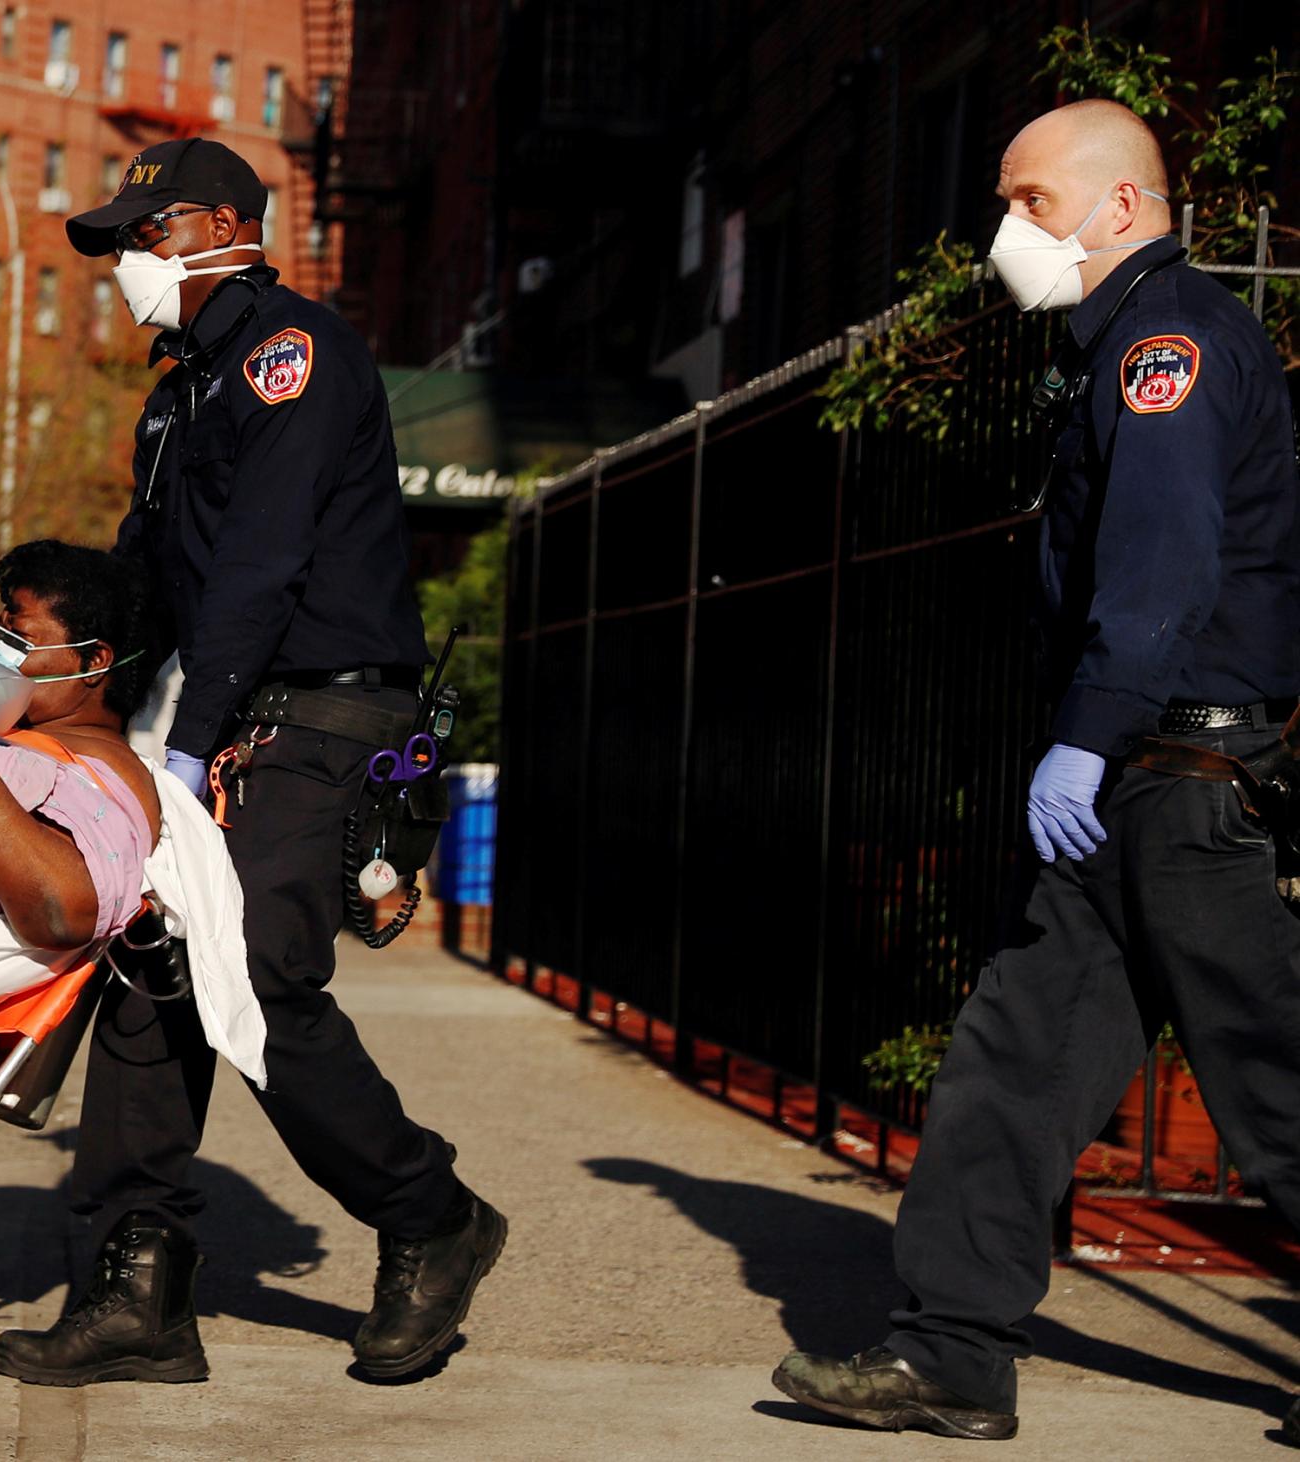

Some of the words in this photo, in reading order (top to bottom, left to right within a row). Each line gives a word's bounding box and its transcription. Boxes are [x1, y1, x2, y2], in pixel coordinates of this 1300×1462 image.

[130, 164, 162, 184] NY
[1142, 341, 1192, 357] DEPARTMENT
[1142, 350, 1160, 359] CITY
[1161, 348, 1172, 356] OF
[1137, 357, 1155, 367] NEW
[1156, 354, 1178, 362] YORK
